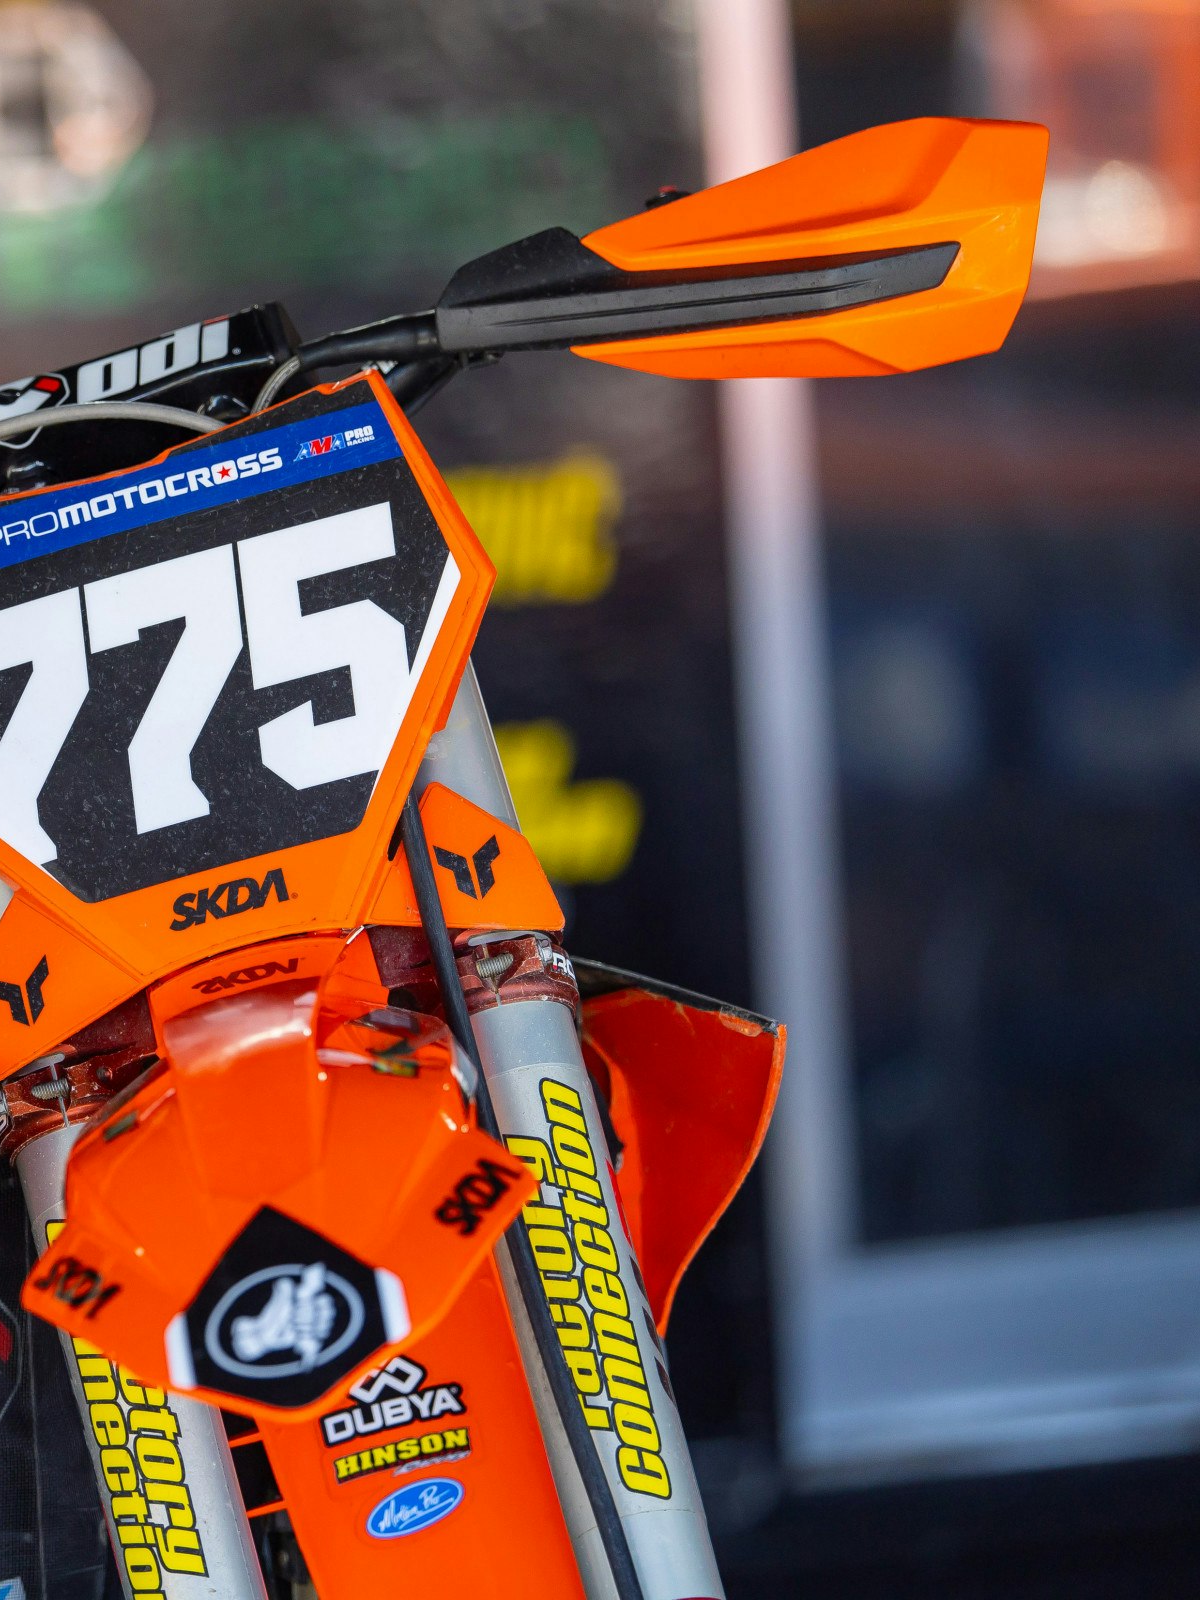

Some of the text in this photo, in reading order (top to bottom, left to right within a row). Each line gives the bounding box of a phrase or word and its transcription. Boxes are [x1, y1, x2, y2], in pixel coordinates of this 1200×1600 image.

[293, 425, 374, 462] AMA PRO
[346, 435, 376, 447] RACING
[169, 868, 291, 932] SKDA
[538, 1076, 673, 1501] connection
[321, 1386, 464, 1446] DUBYA
[334, 1427, 471, 1481] HINSON
